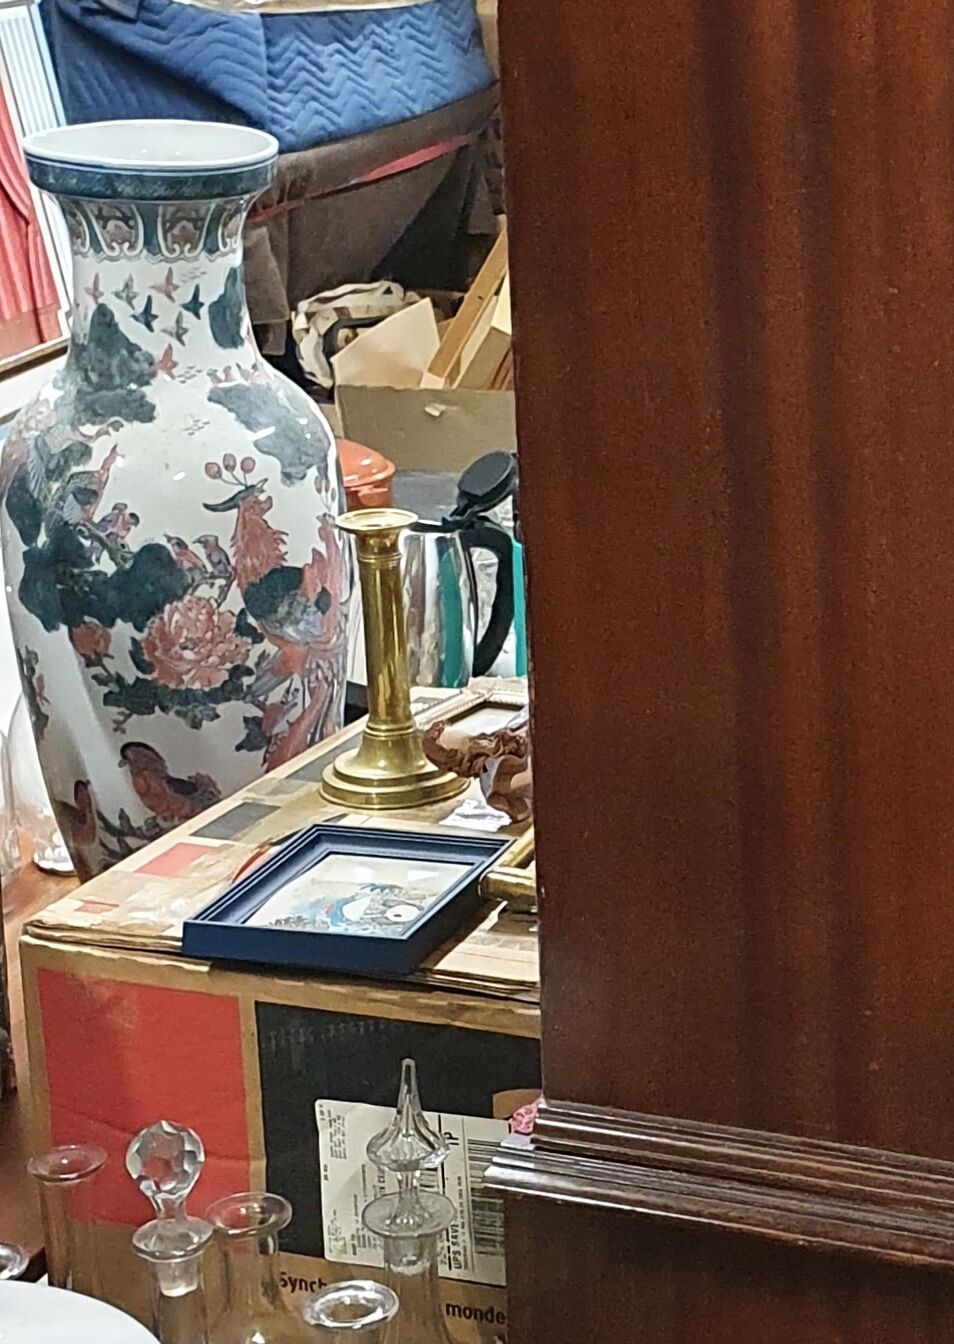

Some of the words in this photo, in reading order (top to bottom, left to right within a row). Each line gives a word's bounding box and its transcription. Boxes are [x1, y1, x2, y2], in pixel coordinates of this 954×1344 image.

[450, 1223, 460, 1247] SAVE
[452, 1250, 463, 1270] UPS
[280, 1271, 328, 1294] Synch
